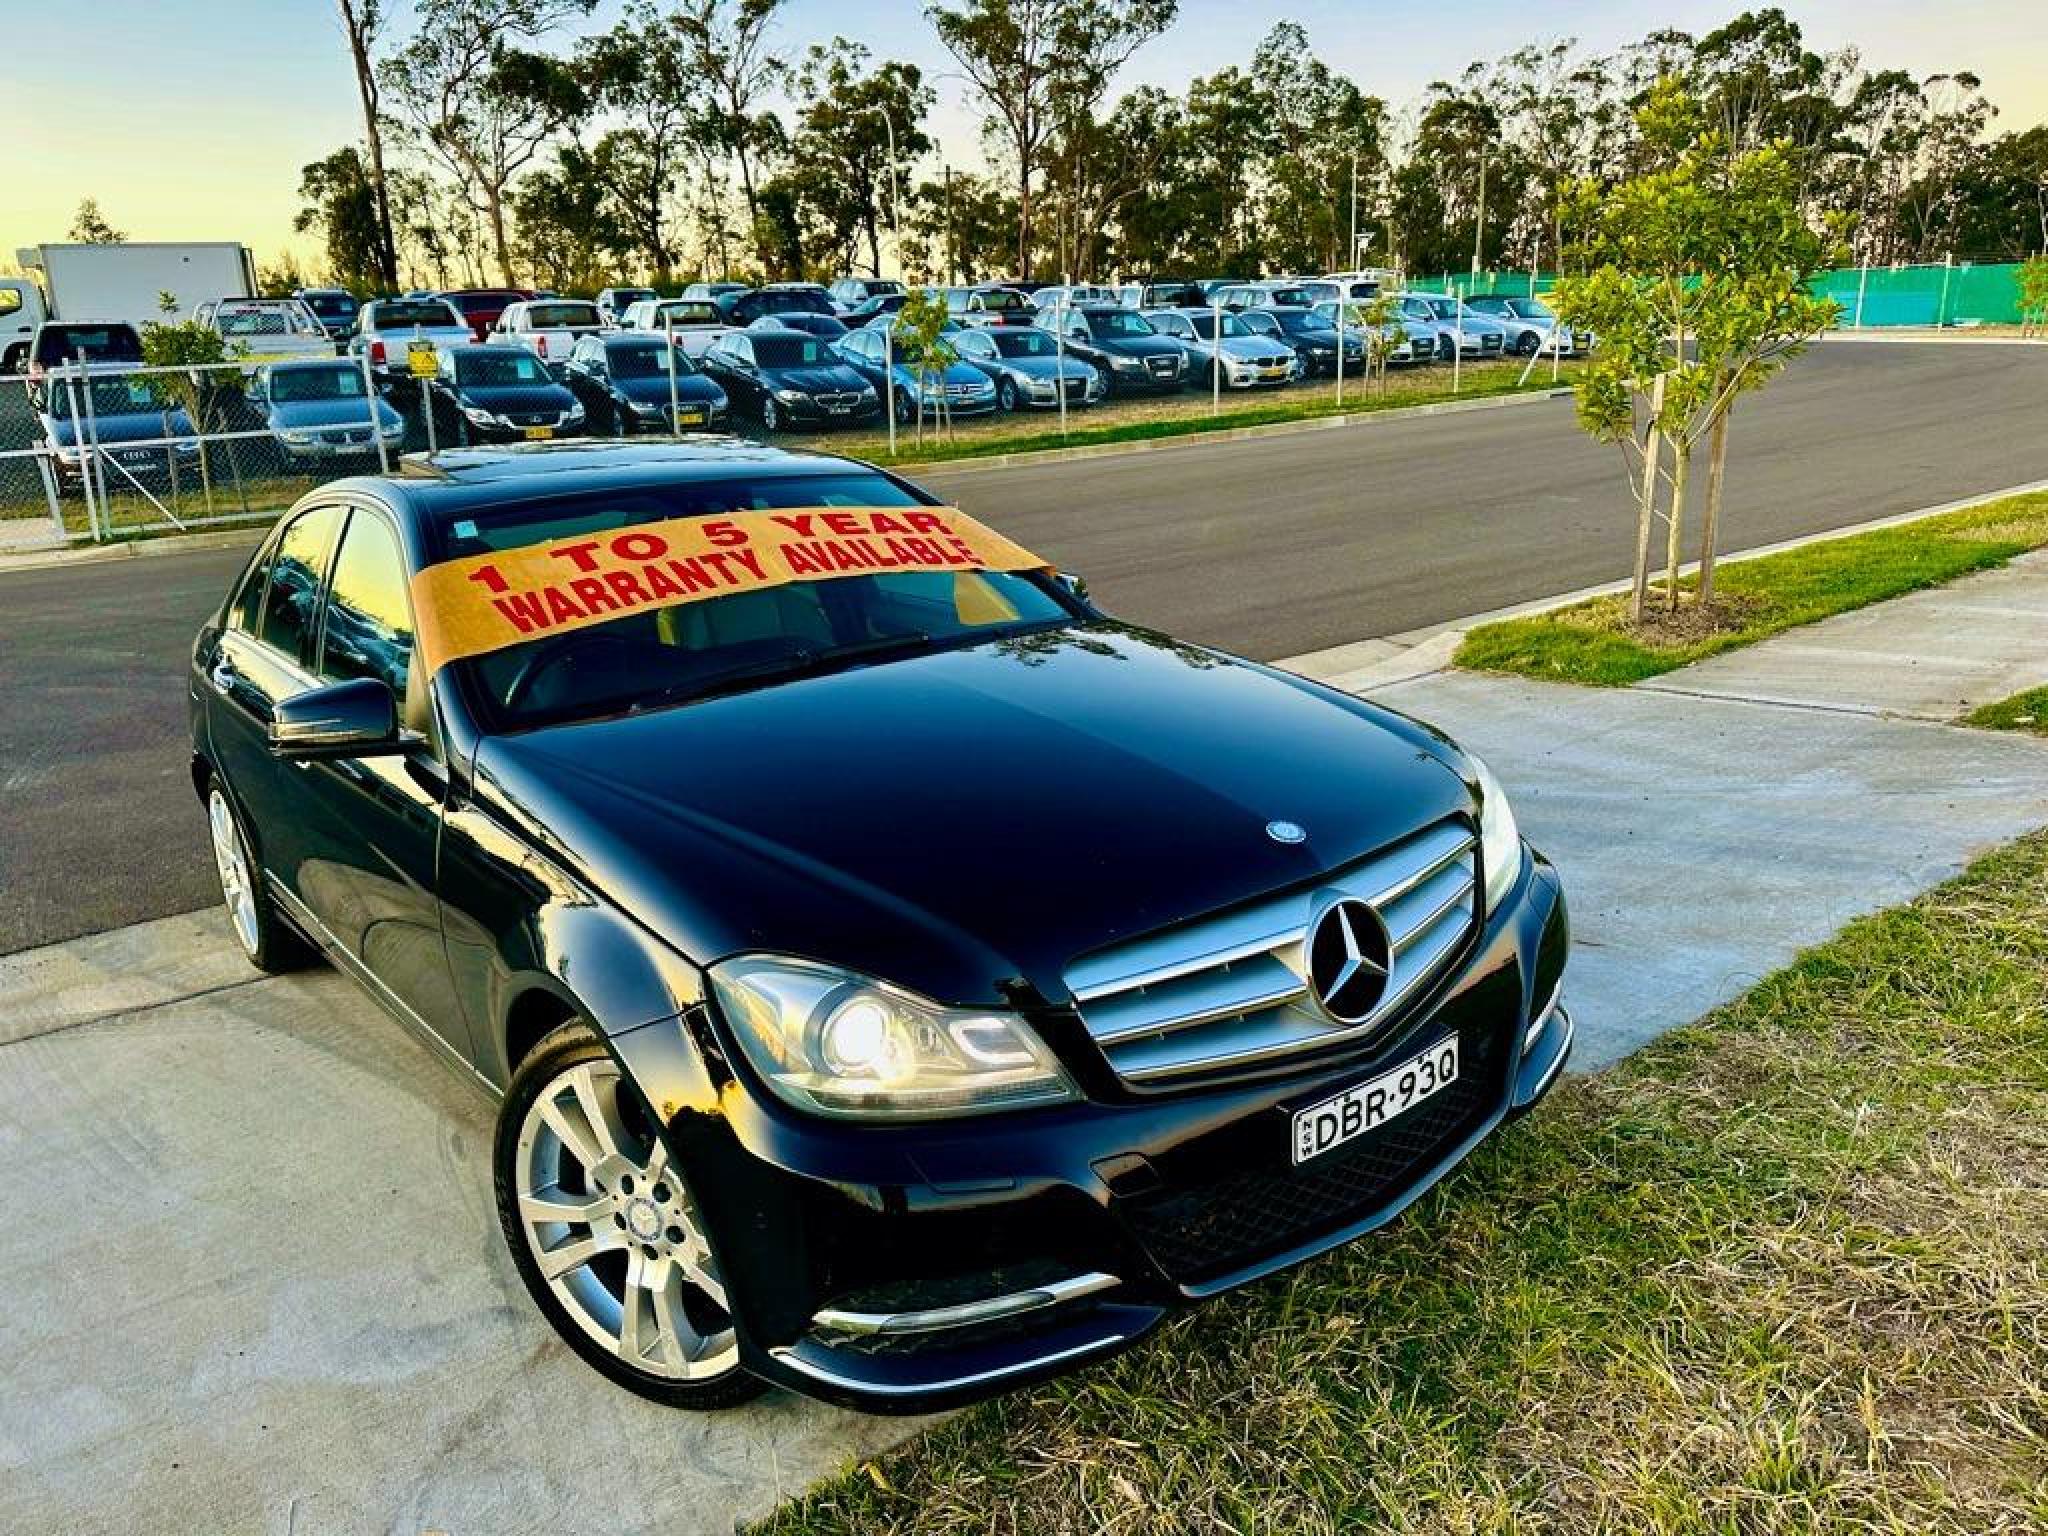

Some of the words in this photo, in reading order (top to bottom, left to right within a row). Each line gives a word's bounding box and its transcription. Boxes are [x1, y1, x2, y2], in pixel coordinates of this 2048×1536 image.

[468, 565, 510, 593] 1
[550, 533, 669, 572] TO
[702, 522, 749, 547] 5
[769, 513, 954, 537] YEAR
[491, 547, 769, 634] WARRANTY
[779, 537, 986, 574] AVAILABLE
